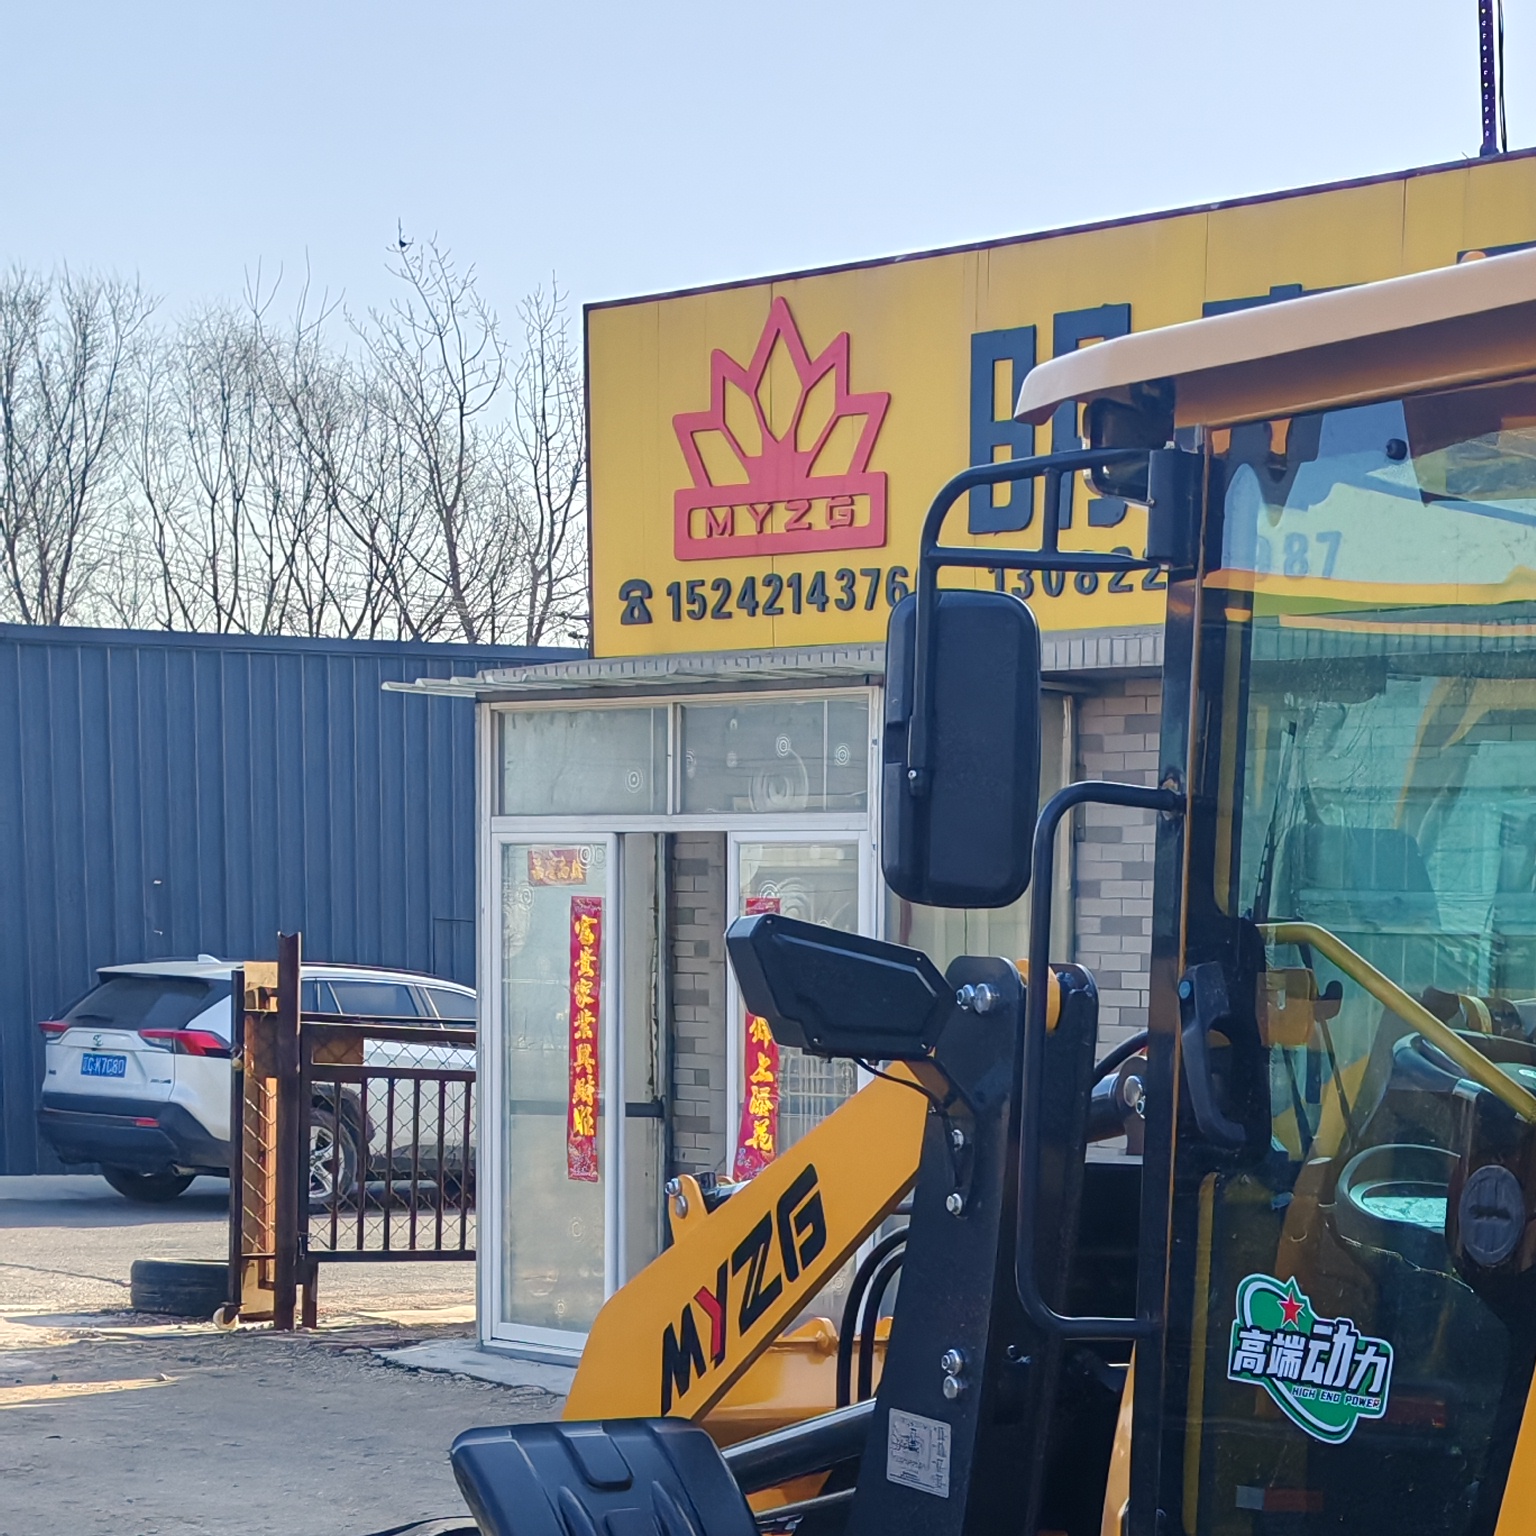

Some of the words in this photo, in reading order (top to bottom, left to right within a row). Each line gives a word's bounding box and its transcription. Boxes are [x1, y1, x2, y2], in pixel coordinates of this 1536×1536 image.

[705, 494, 856, 538] MYZG
[666, 565, 918, 621] 1524214376
[661, 1163, 827, 1417] MYZG
[1232, 1325, 1388, 1393] 高端动力
[1292, 1386, 1317, 1399] HIGH
[1320, 1389, 1341, 1403] END
[1345, 1394, 1381, 1409] POWER
